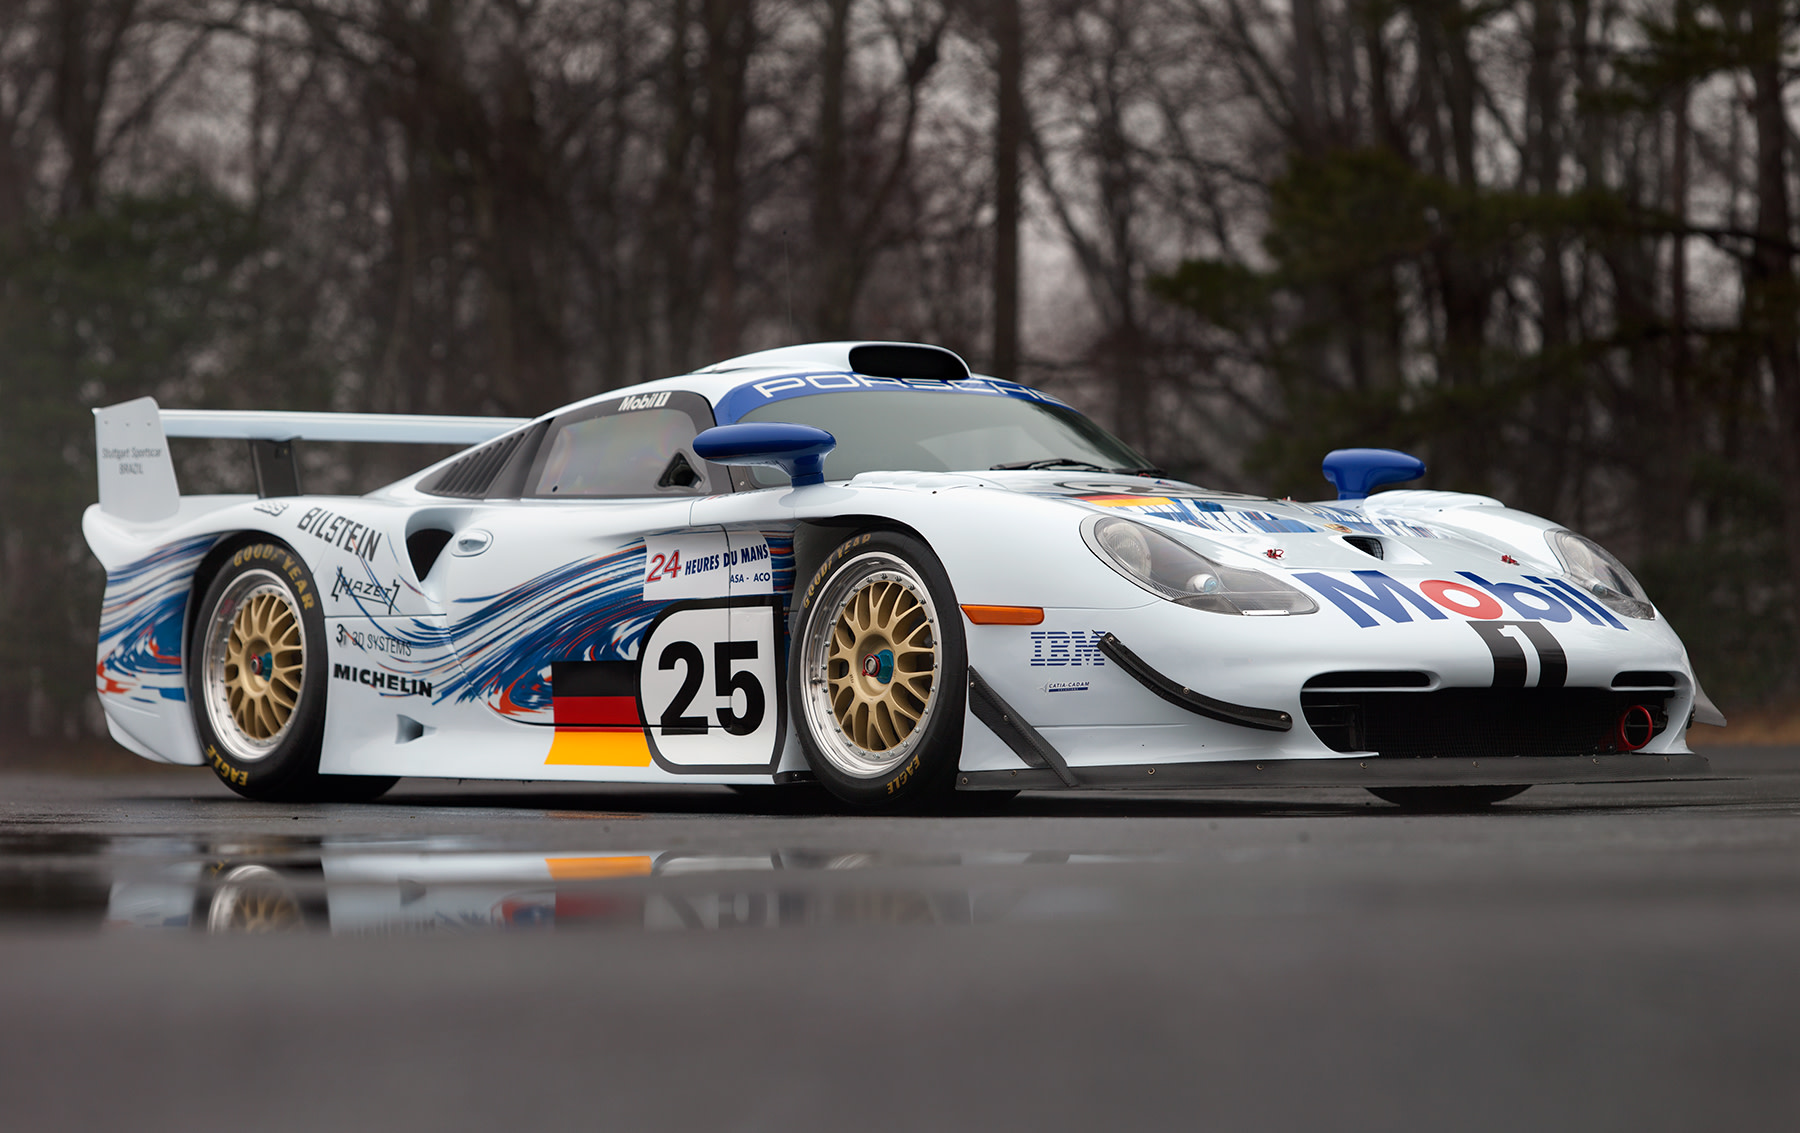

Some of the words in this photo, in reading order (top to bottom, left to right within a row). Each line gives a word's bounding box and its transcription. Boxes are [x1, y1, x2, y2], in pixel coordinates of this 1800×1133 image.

[618, 392, 659, 412] Mobil
[753, 374, 1071, 409] PORSCHE
[102, 447, 130, 459] Stuttgart
[131, 446, 162, 459] Sportscar
[119, 462, 144, 475] BRAZIL
[296, 507, 383, 563] BILSTEIN
[645, 549, 682, 585] 24
[685, 553, 720, 576] HEURES
[723, 549, 738, 568] DU
[740, 543, 769, 564] MANS
[729, 573, 745, 584] ASA
[752, 572, 771, 583] ACO
[336, 574, 394, 601] HAZET
[1292, 570, 1629, 631] Mobil
[366, 633, 412, 657] SYSTEMS
[1030, 631, 1106, 667] IBM
[1492, 622, 1546, 688] 1
[333, 663, 433, 698] MICHELIN
[657, 640, 766, 737] 25
[1048, 681, 1090, 689] CATIA-CADAM
[205, 743, 249, 787] EAGLE
[886, 753, 921, 795] EAGLE
